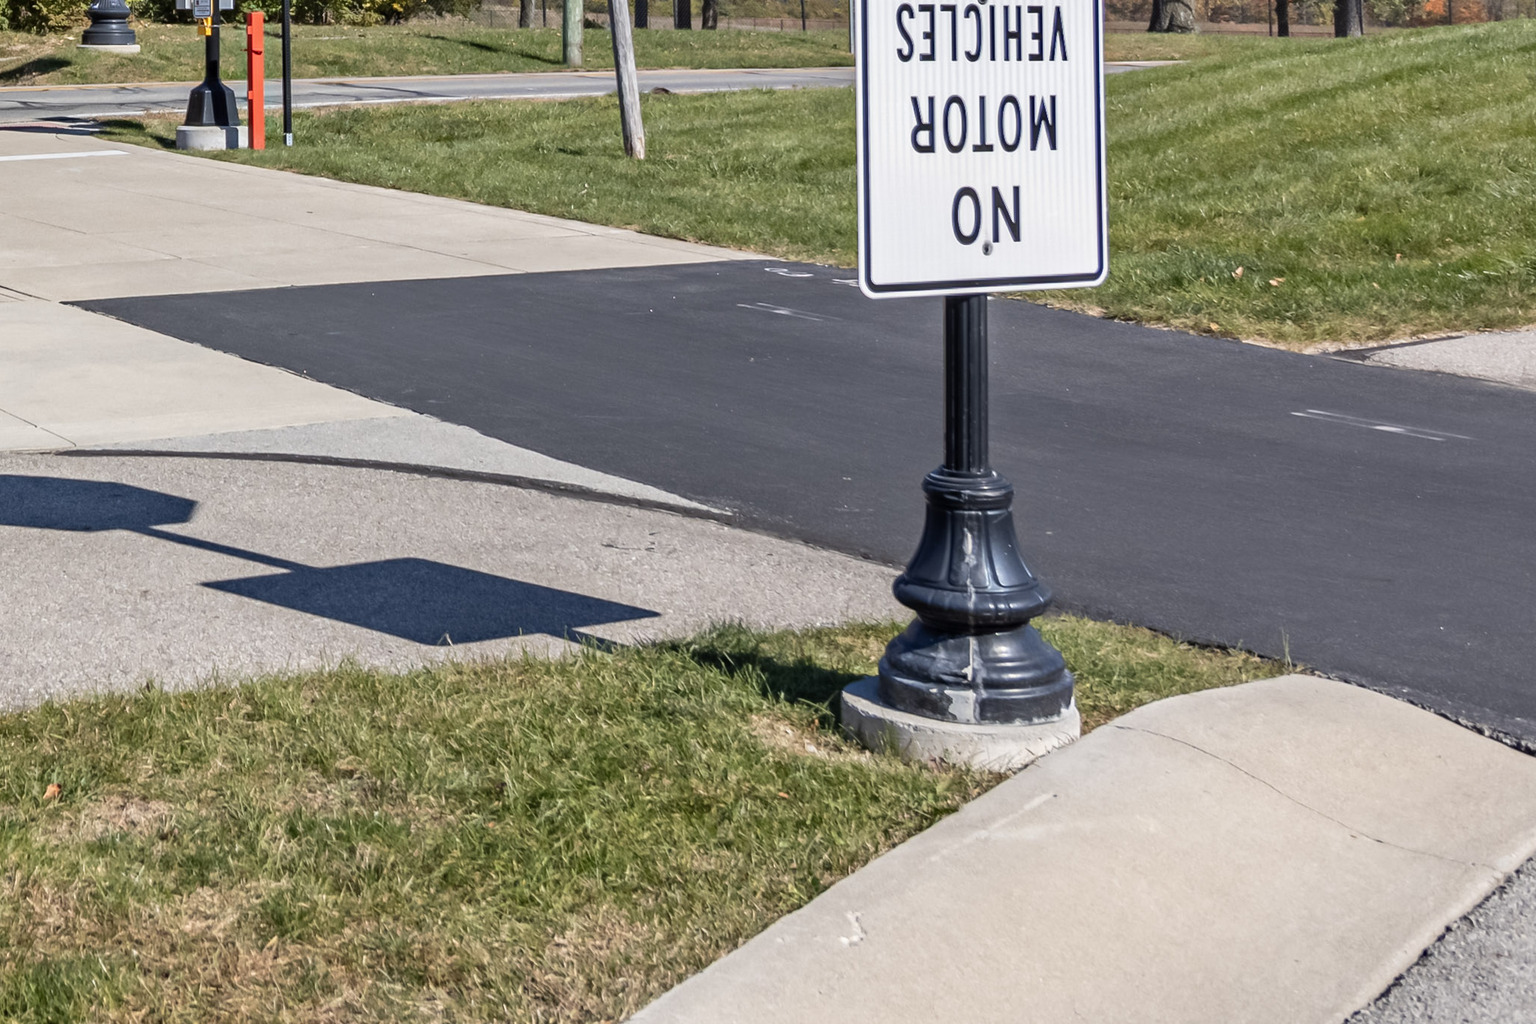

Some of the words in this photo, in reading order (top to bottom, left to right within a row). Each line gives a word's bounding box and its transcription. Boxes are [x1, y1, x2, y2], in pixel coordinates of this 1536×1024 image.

[896, 2, 1068, 63] VEHICLES
[910, 94, 1057, 153] MOTOR
[951, 185, 1021, 245] NO
